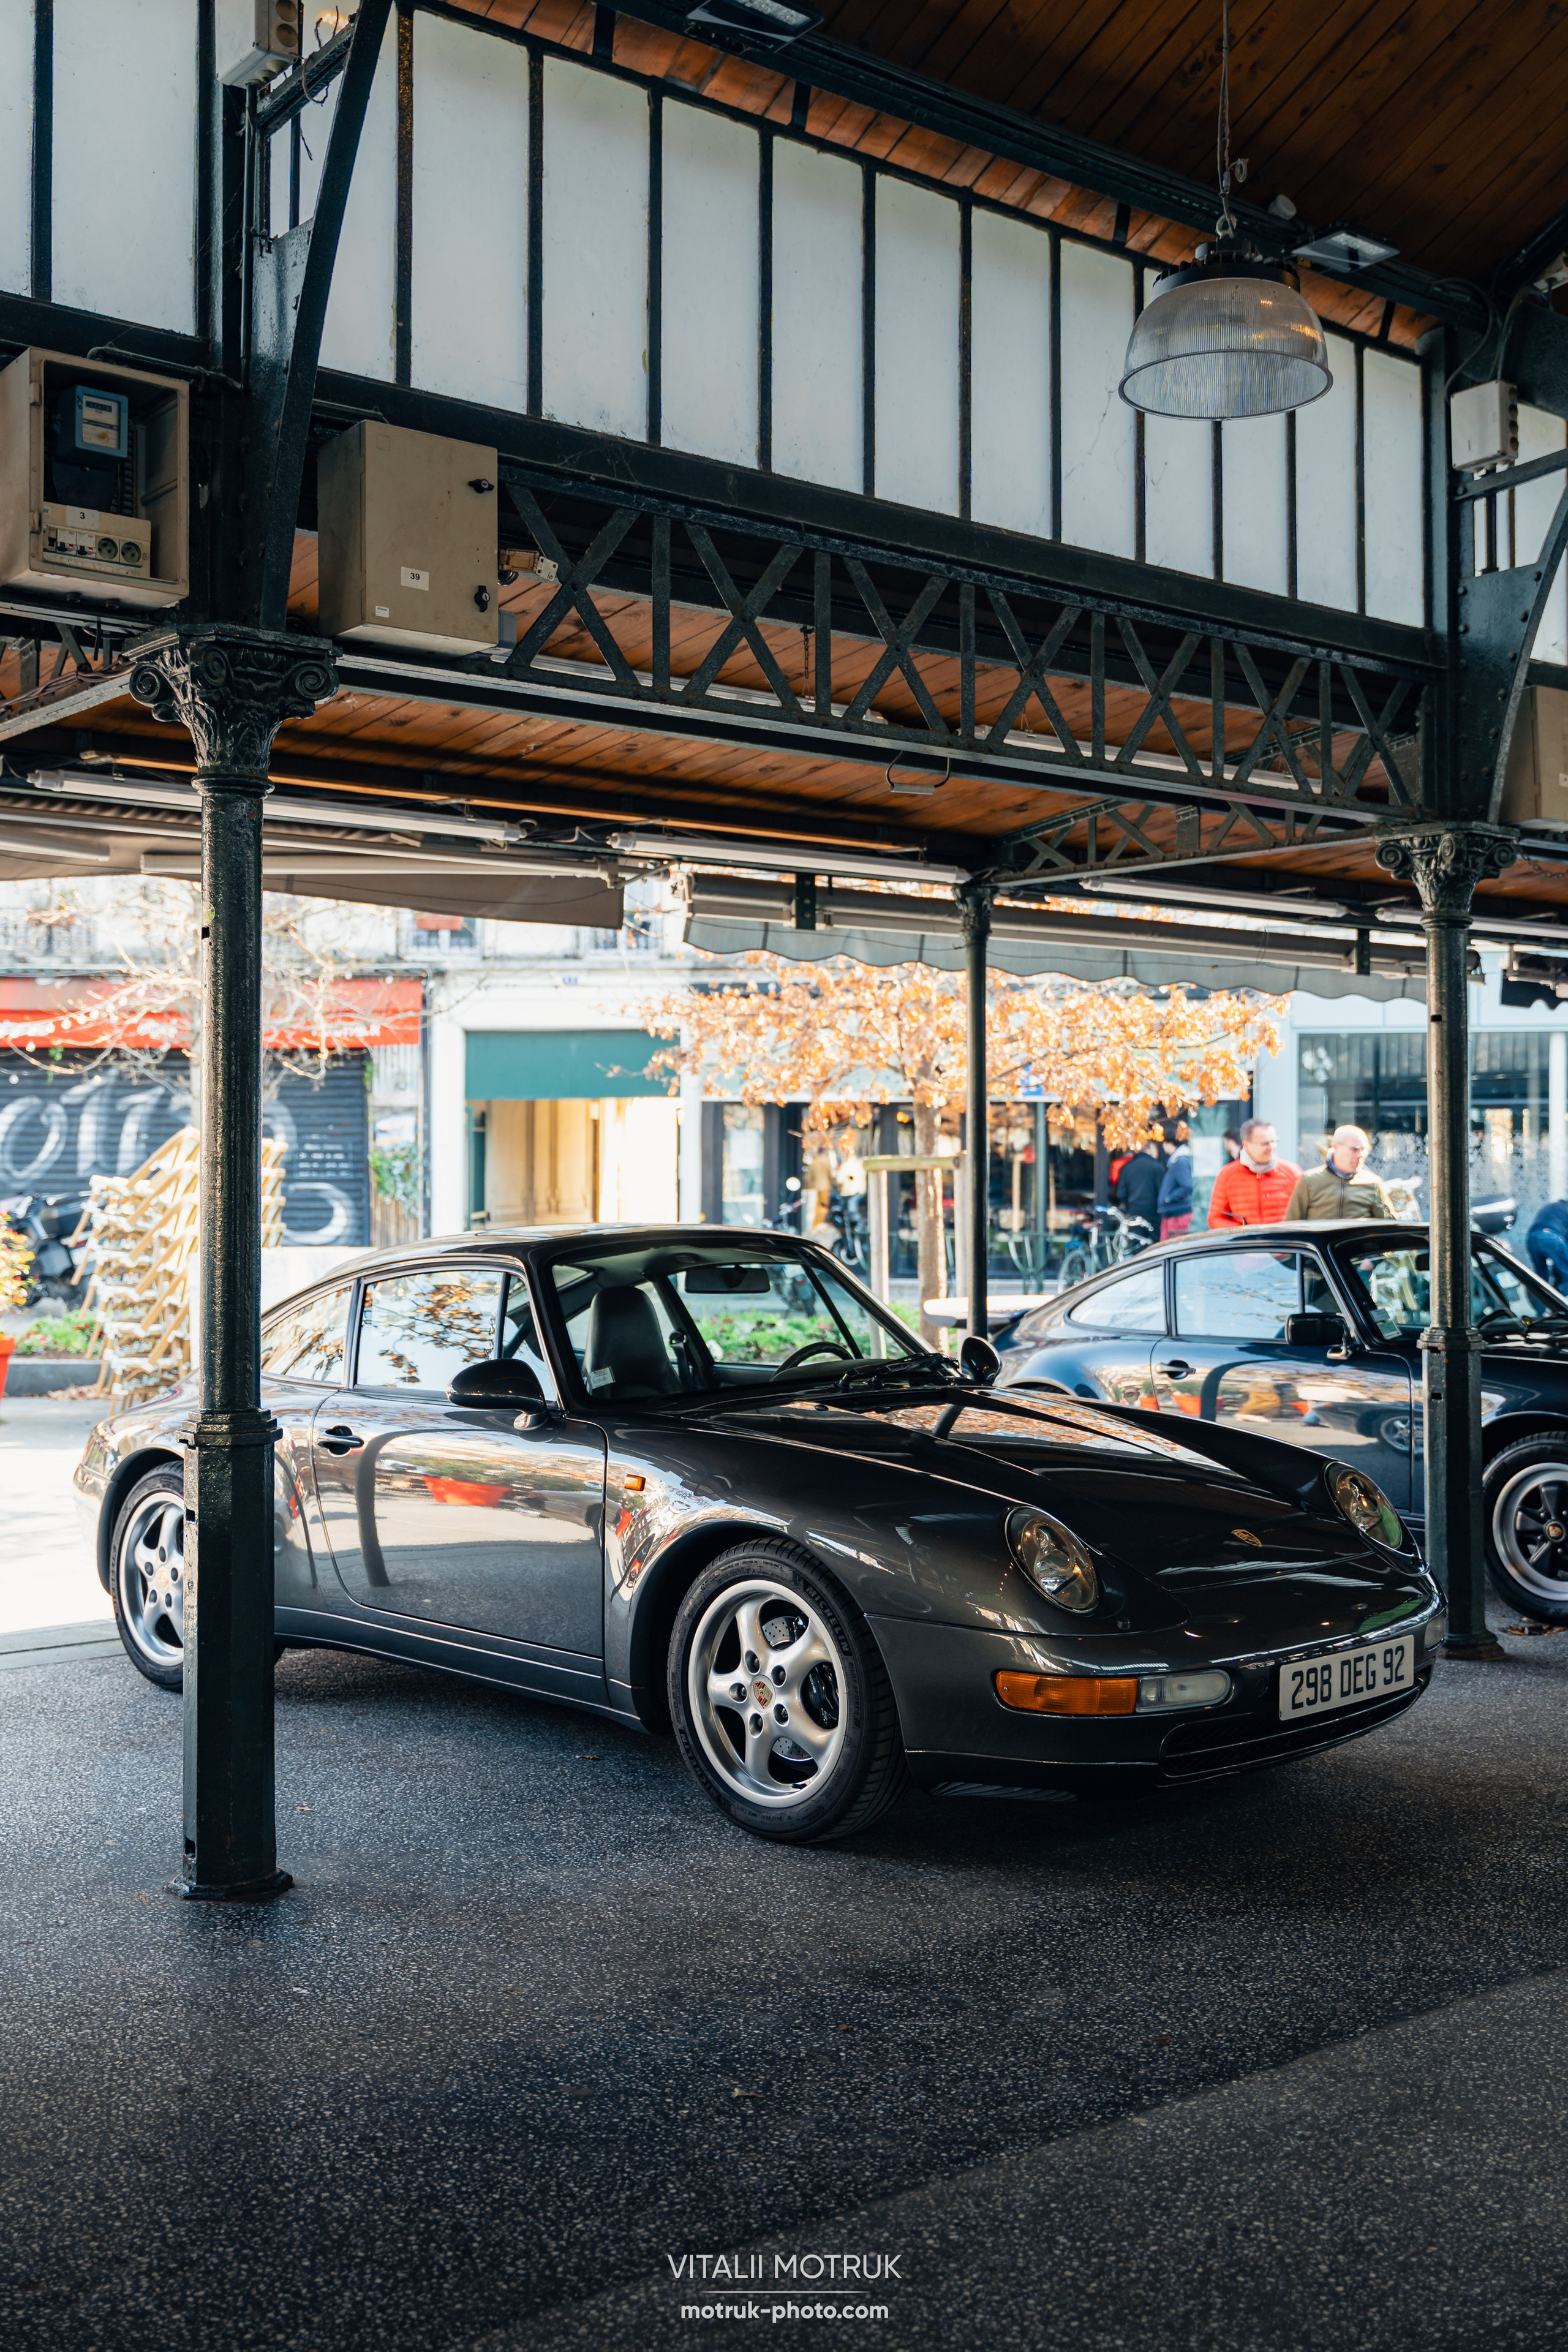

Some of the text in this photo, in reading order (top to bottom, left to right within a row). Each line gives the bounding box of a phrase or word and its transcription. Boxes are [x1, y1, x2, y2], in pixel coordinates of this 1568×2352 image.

[410, 572, 420, 581] 39
[806, 1585, 850, 1652] MICHELIN
[1291, 1645, 1404, 1710] 298 DEG 92
[680, 1733, 719, 1798] MICHELIN
